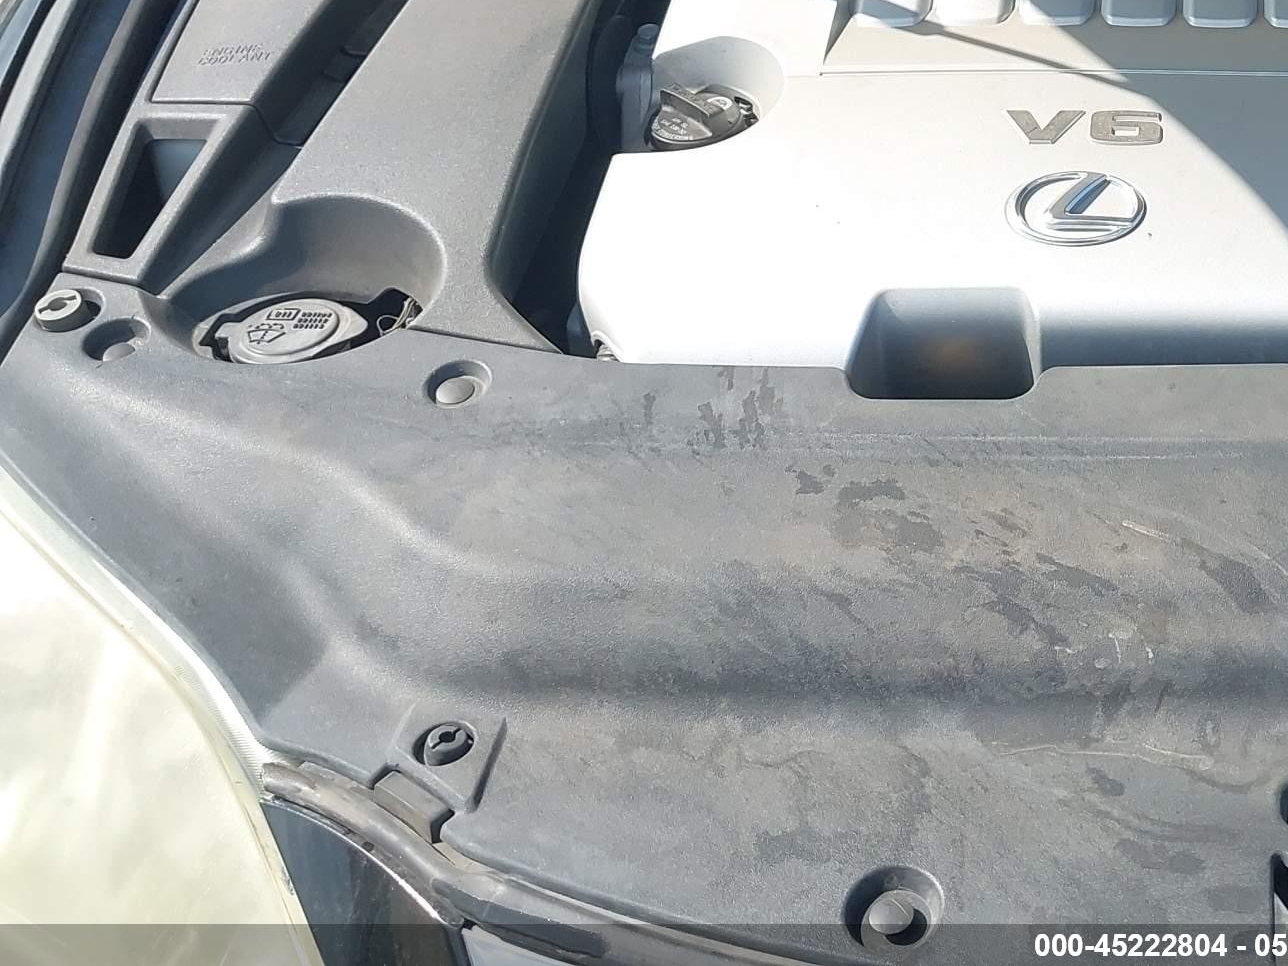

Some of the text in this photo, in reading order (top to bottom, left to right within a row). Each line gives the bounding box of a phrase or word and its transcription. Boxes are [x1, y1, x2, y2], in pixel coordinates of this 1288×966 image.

[202, 43, 264, 56] ENGINE
[197, 51, 272, 66] COOLANT
[1006, 109, 1165, 147] V6
